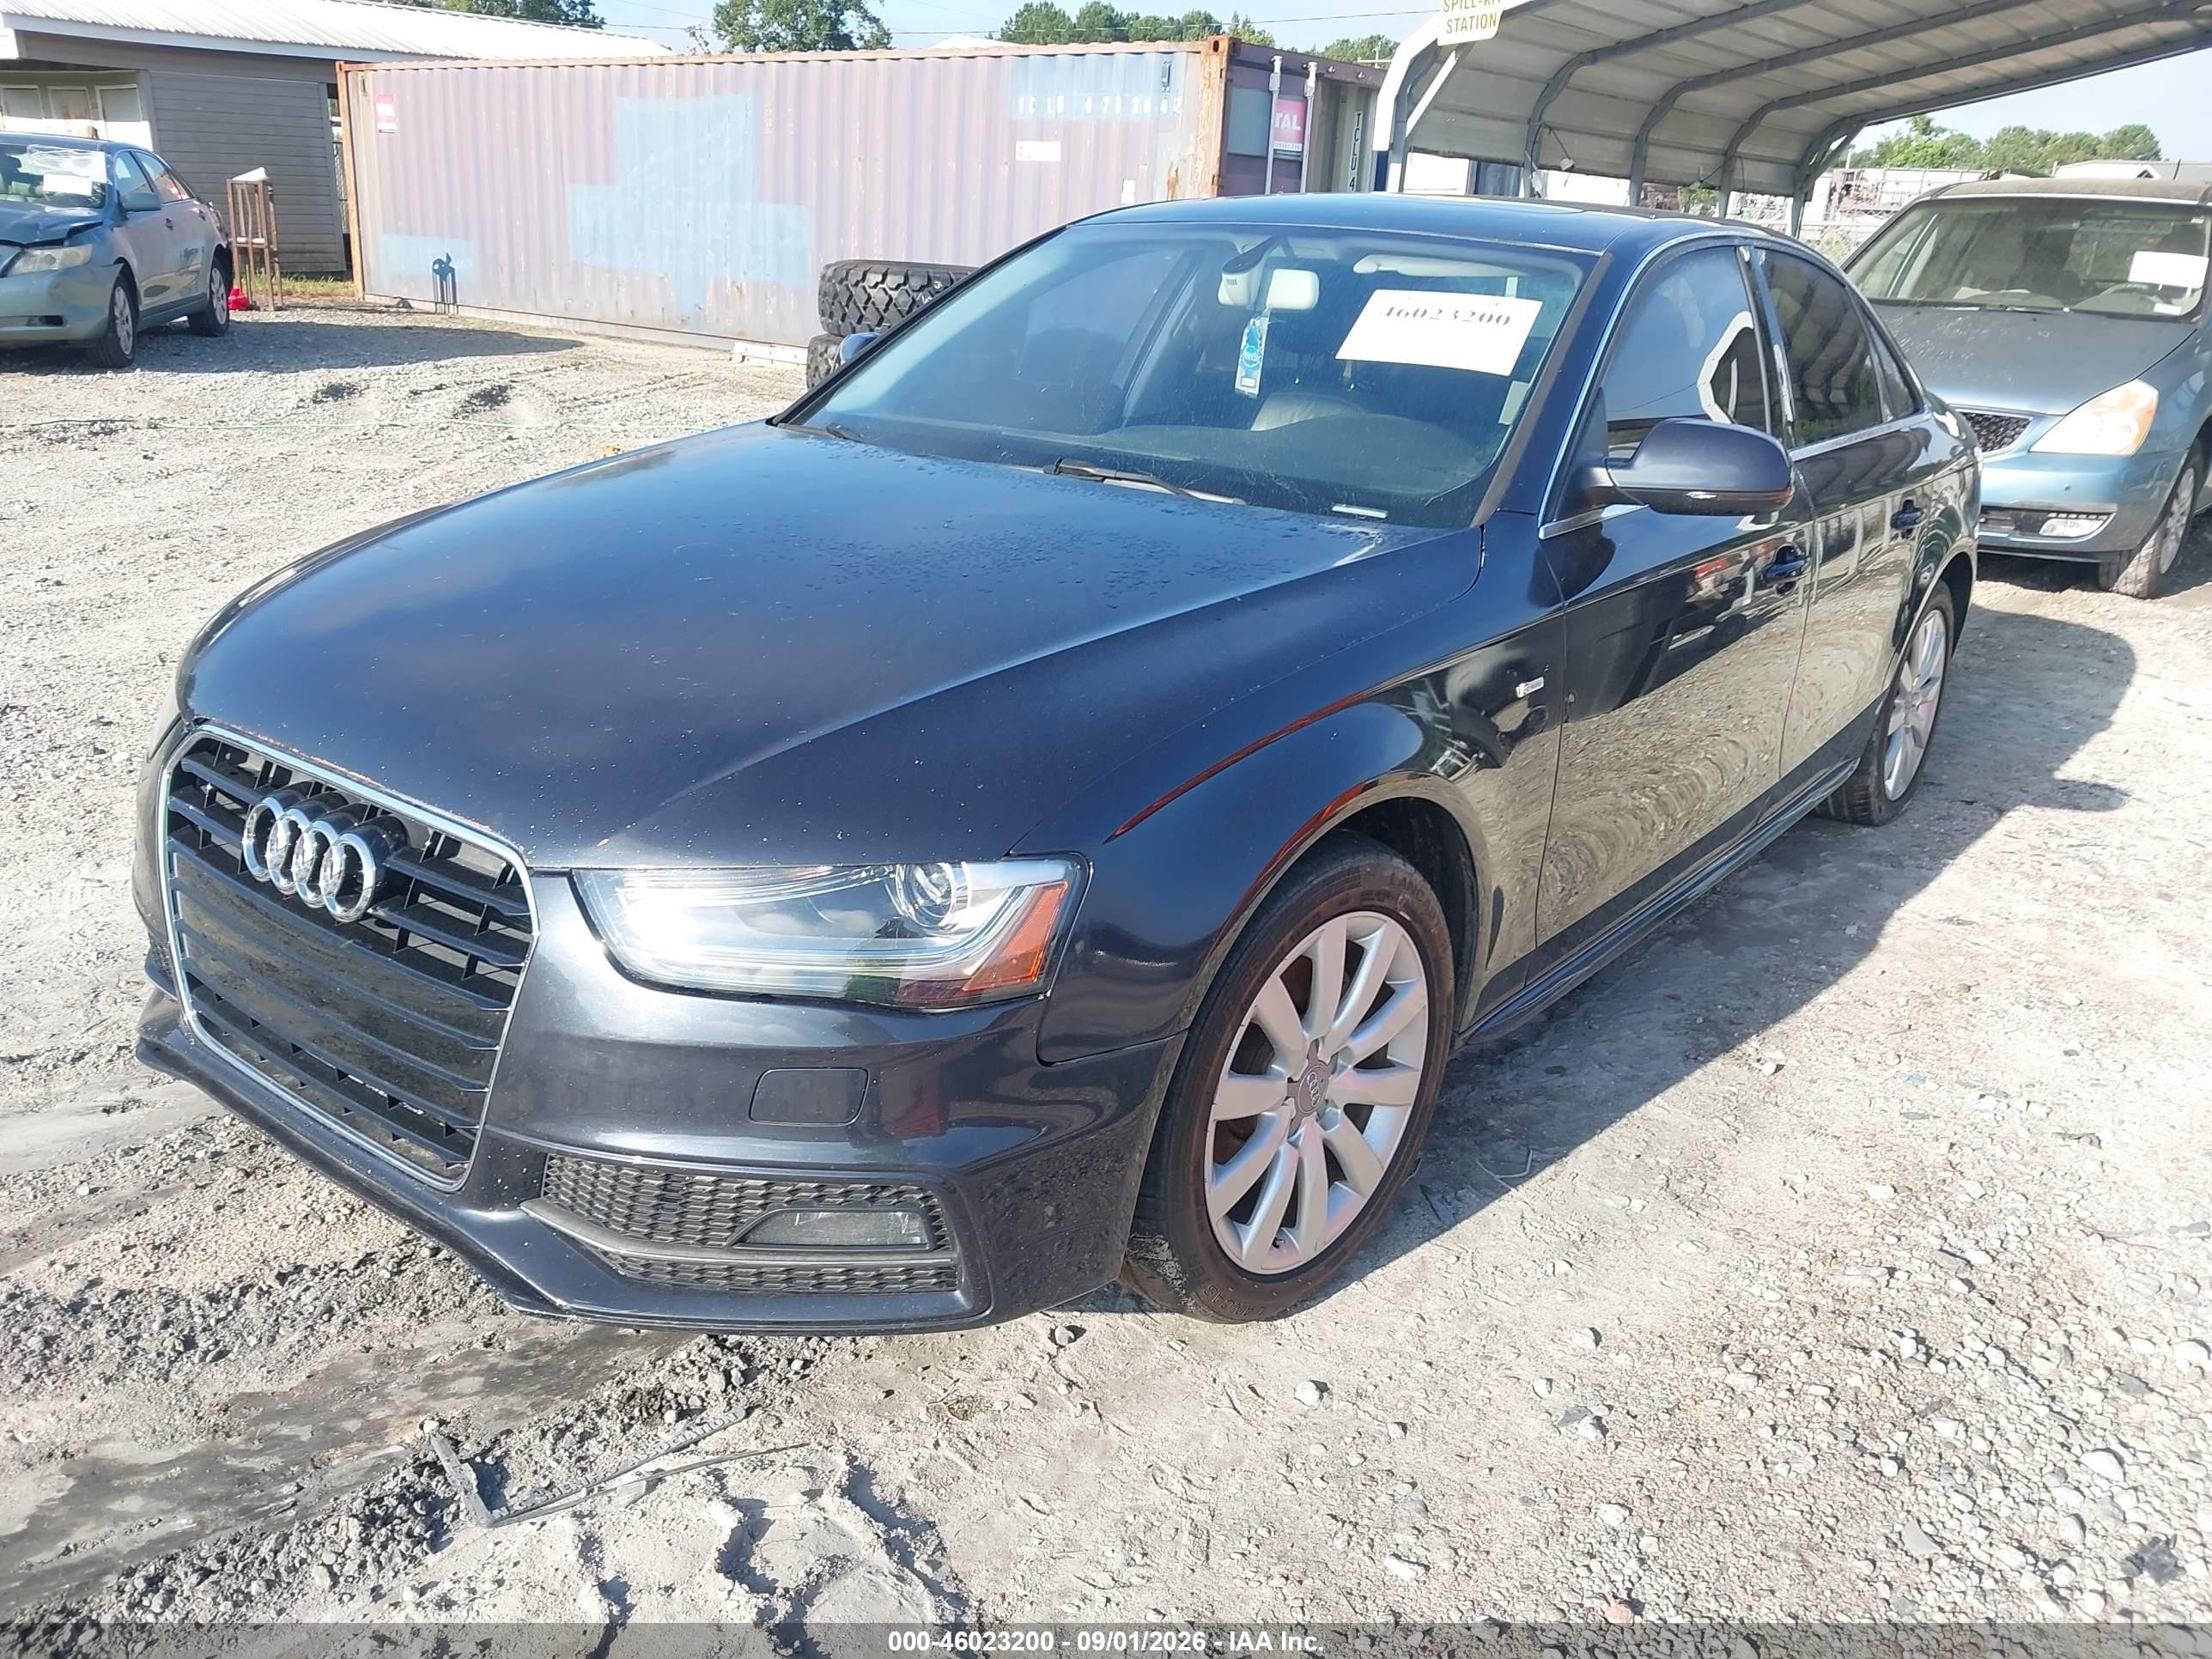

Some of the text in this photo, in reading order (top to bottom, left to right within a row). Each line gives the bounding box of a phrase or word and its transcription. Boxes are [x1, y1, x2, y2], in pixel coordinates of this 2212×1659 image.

[1443, 0, 1500, 13] SPILL-
[1446, 12, 1497, 33] STATION
[1350, 112, 1363, 171] TCLU
